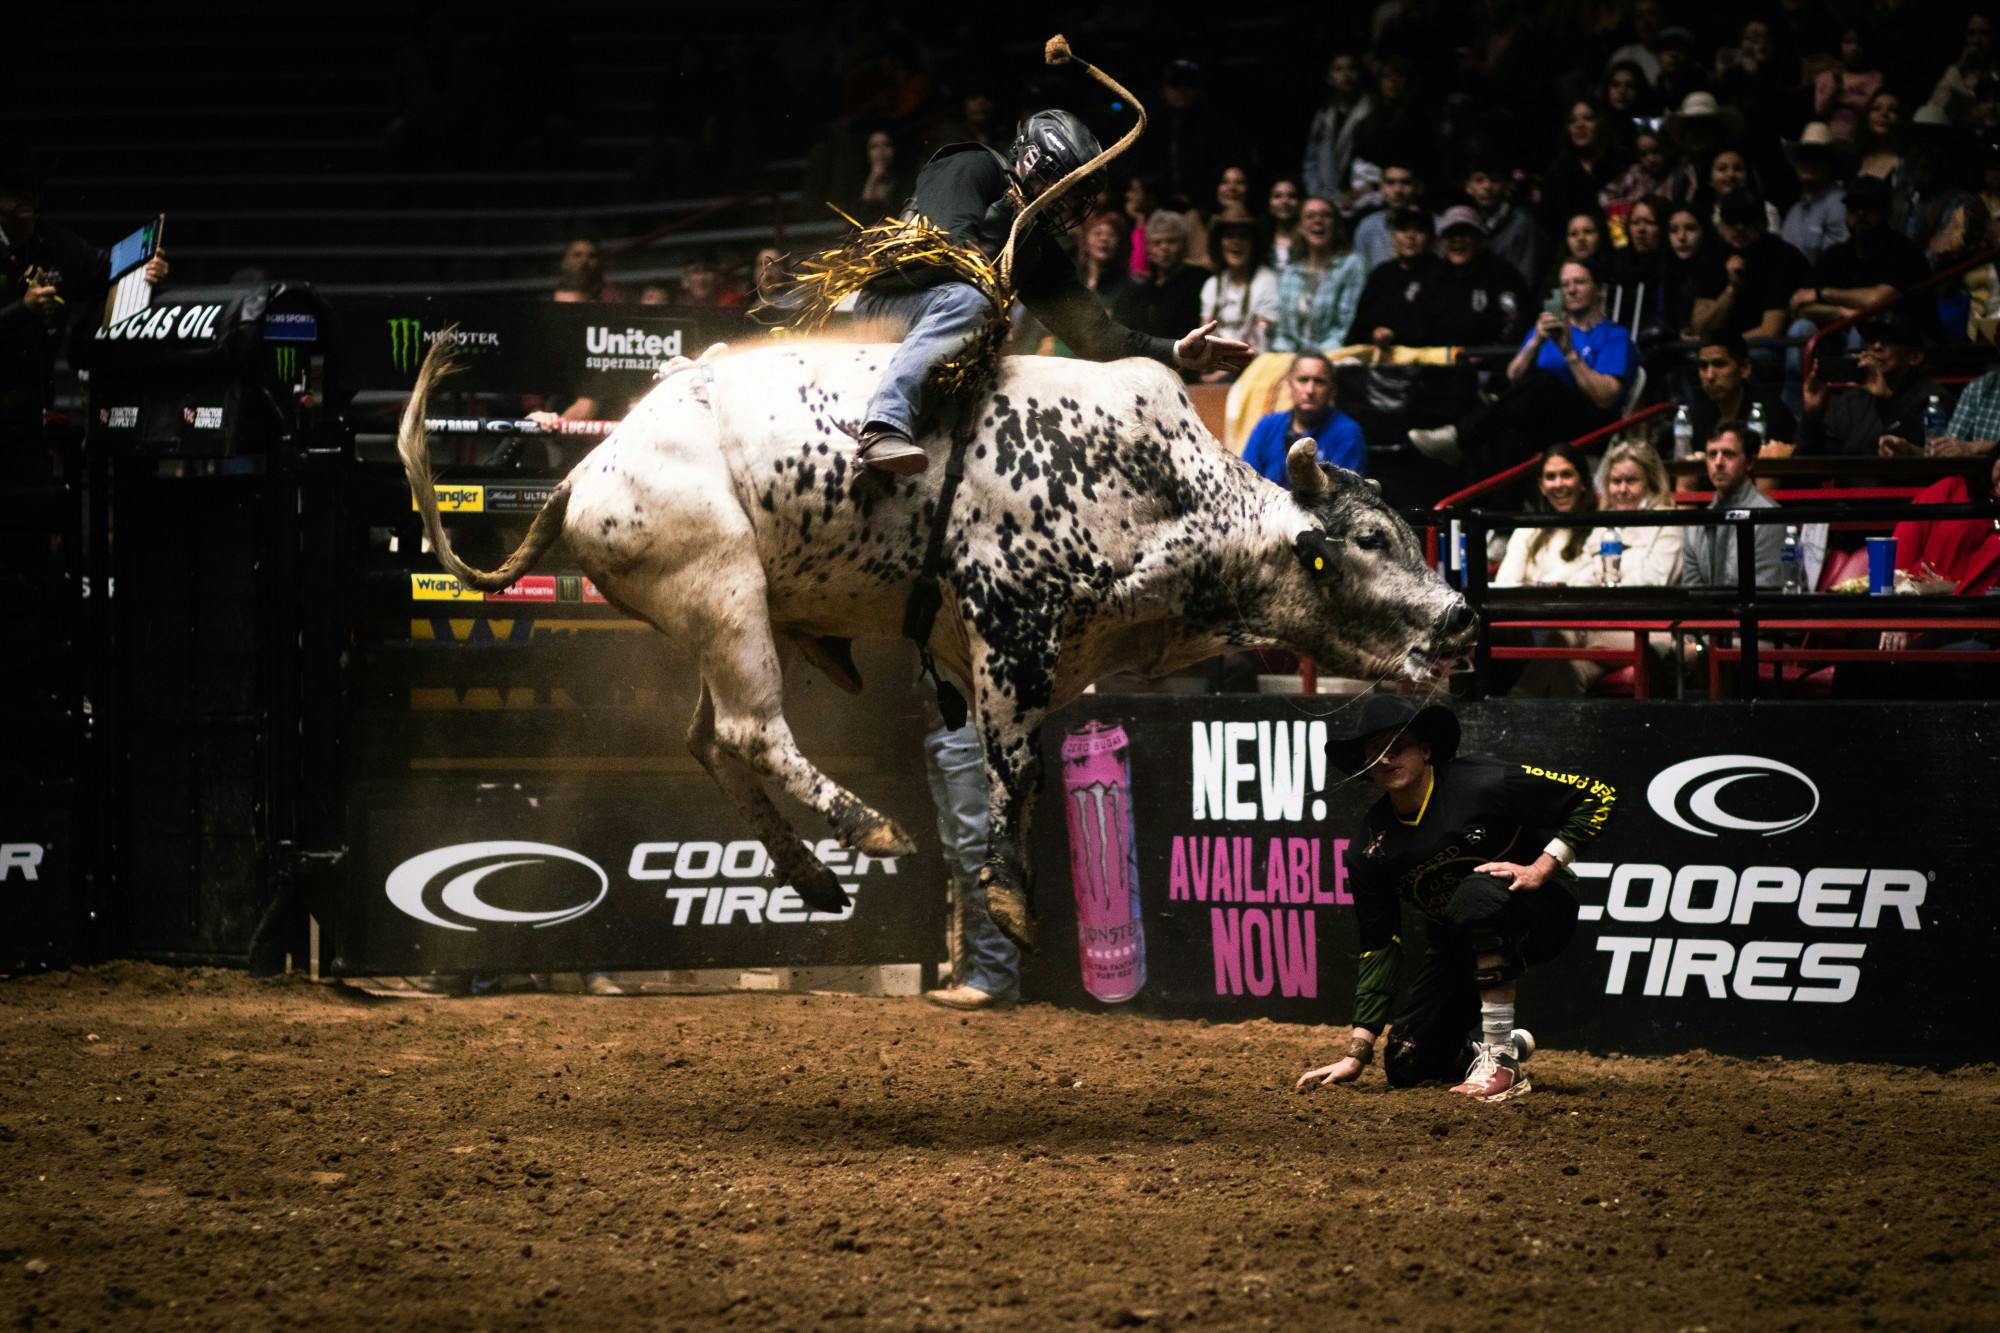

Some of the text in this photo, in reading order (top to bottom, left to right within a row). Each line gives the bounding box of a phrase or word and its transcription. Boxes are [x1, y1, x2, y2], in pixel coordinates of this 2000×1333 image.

[177, 304, 222, 340] OIL
[586, 326, 683, 356] United
[586, 356, 669, 372] supermark
[424, 419, 447, 432] OOT
[561, 420, 601, 434] LUCAS
[435, 489, 478, 508] angler
[416, 577, 464, 598] Wrang
[1191, 720, 1328, 822] NEW!
[1520, 763, 1590, 790] PATROL
[627, 838, 898, 881] COOER
[1169, 835, 1355, 905] AVAILABLE
[1568, 862, 1928, 931] COOPER
[1083, 921, 1138, 945] ONSTE
[1210, 907, 1318, 999] NOW
[1596, 936, 1867, 1004] TIRES
